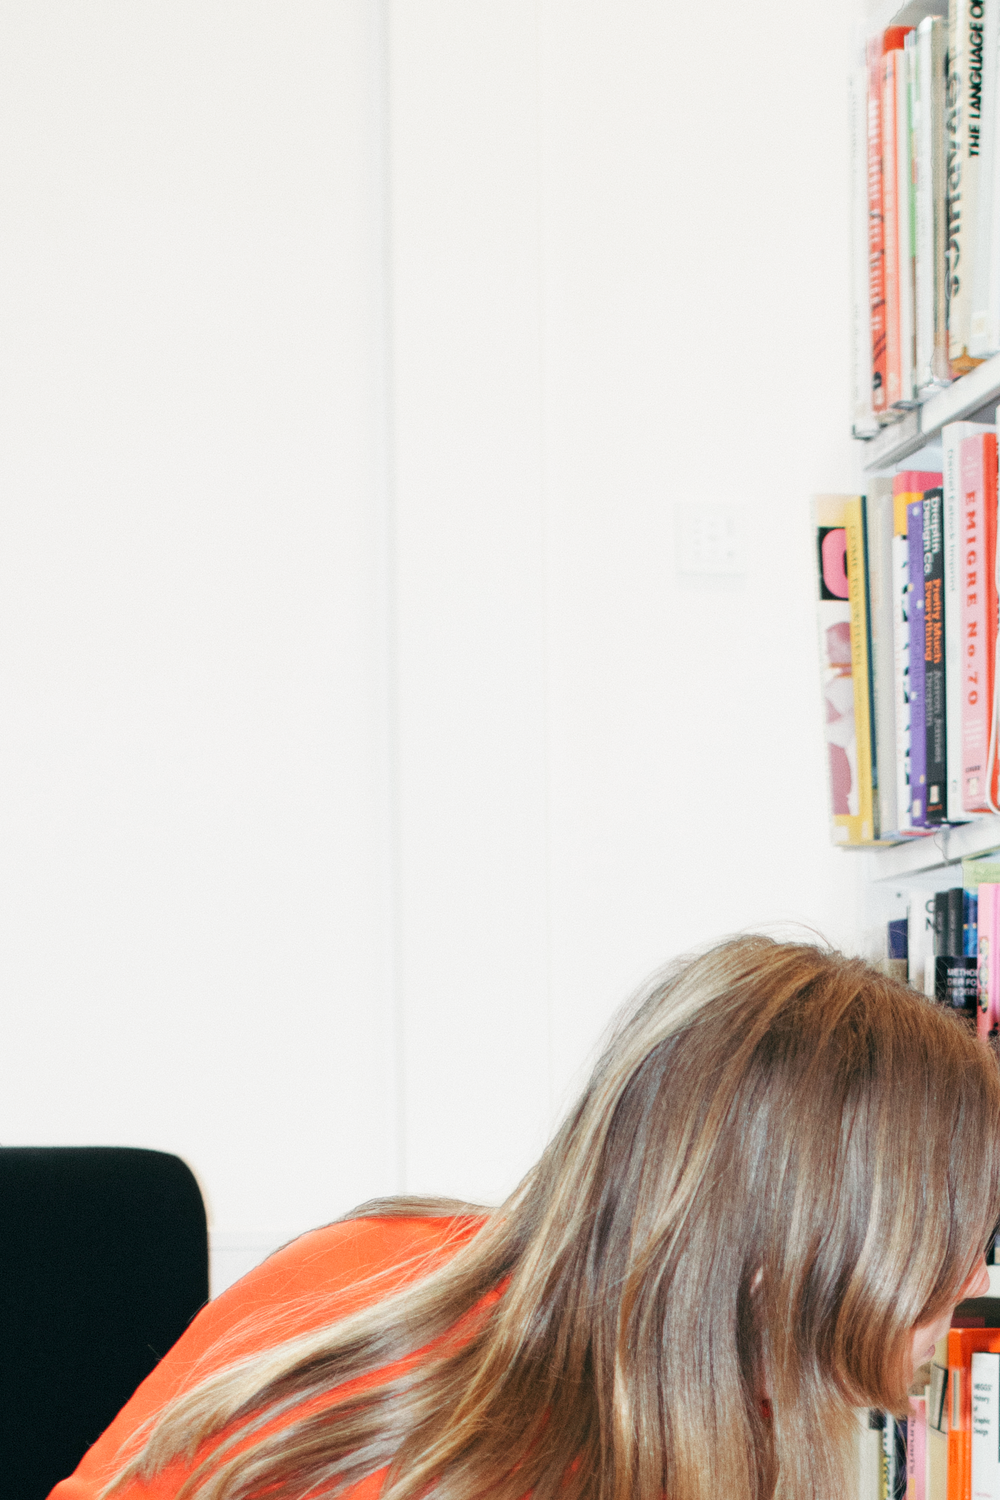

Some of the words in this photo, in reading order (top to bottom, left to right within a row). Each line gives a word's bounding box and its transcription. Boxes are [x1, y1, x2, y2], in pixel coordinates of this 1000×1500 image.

[968, 22, 984, 119] LANGUAGE
[968, 124, 981, 159] THE
[930, 496, 941, 554] Draplin
[965, 490, 978, 608] EMIGRE
[932, 621, 942, 665] Much
